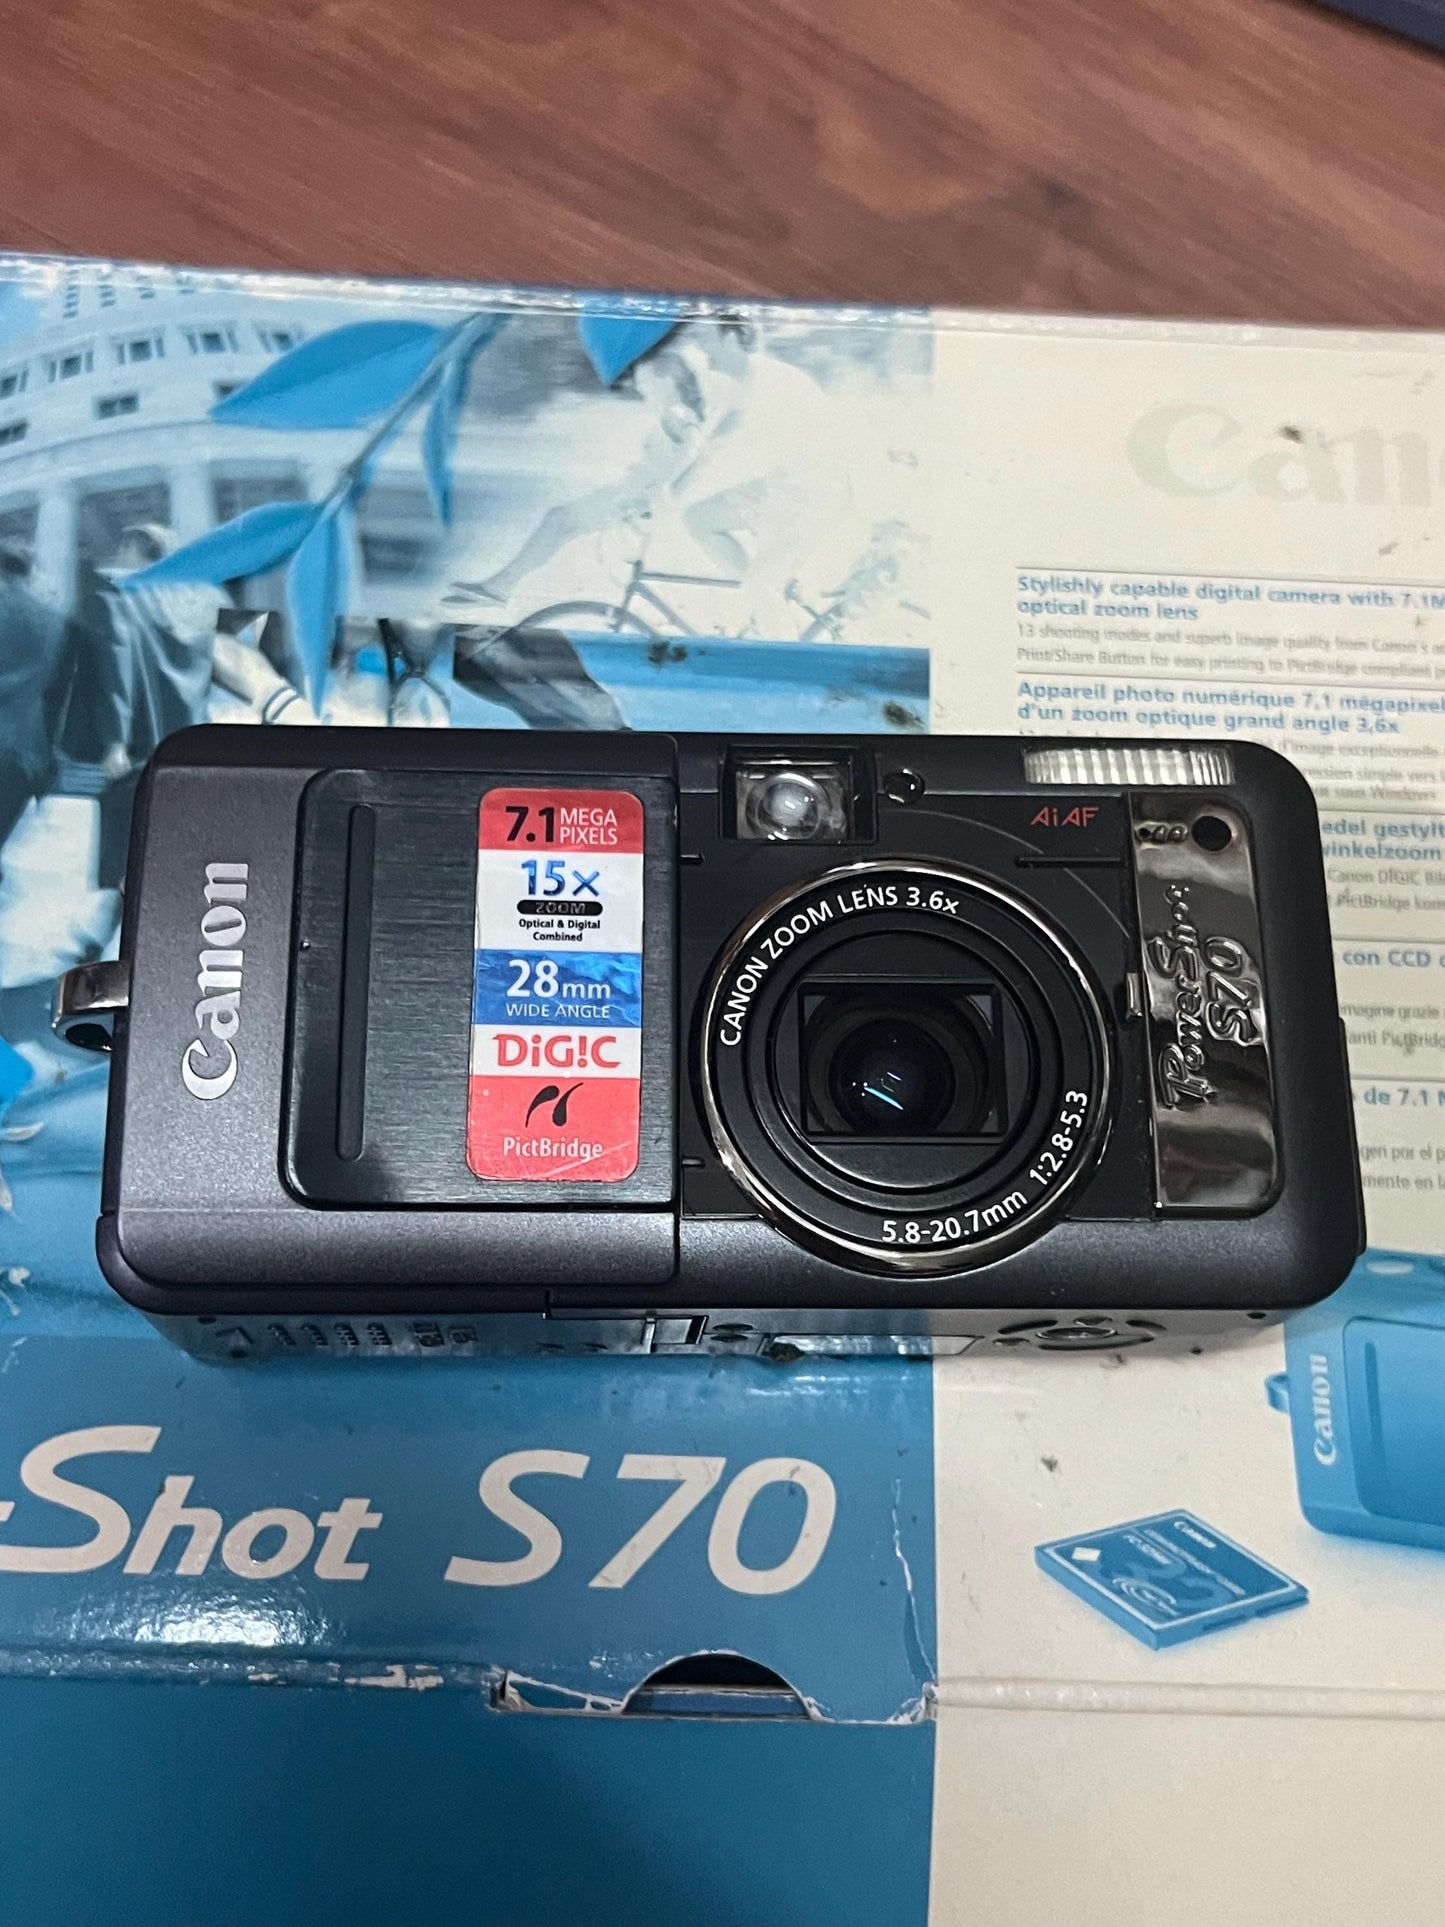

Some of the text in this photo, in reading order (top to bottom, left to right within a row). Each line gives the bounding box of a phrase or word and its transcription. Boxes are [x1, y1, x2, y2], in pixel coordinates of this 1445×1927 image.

[1018, 575, 1103, 597] Stylishly
[1111, 581, 1190, 600] capable
[1196, 583, 1260, 603] digital
[1268, 590, 1341, 604] camera
[1347, 590, 1395, 606] with
[1018, 600, 1198, 620] optical zoom lens
[1018, 623, 1034, 638] 13
[1018, 681, 1105, 701] Appareil
[1113, 685, 1174, 703] photo
[1182, 688, 1295, 708] numérique
[1018, 703, 1063, 720] d'un
[1072, 708, 1128, 722] zoom
[1136, 709, 1217, 730] optique
[1224, 711, 1285, 731] grand
[1292, 714, 1349, 734] angle
[505, 805, 555, 843] 7.1
[560, 808, 617, 826] MEGA
[1030, 806, 1099, 827] AiAF
[560, 827, 618, 845] PIXELS
[535, 902, 586, 915] ZOOM
[519, 918, 601, 932] Optical & Digital
[533, 931, 583, 942] Combined
[720, 884, 959, 1046] CANON ZOOM LENS 3.6x
[1342, 952, 1380, 966] con
[1388, 949, 1431, 968] CCD
[182, 862, 249, 1100] Canon
[507, 958, 611, 999] 28mm
[1204, 936, 1262, 1047] S70
[506, 1003, 610, 1019] WIDE ANGLE
[1364, 1086, 1391, 1106] de
[503, 1136, 603, 1163] PictBridge
[882, 1090, 1088, 1244] 5.8-20.7mm 1:2.8-5.3
[1309, 1353, 1337, 1466] Canon
[444, 1448, 838, 1595] S70
